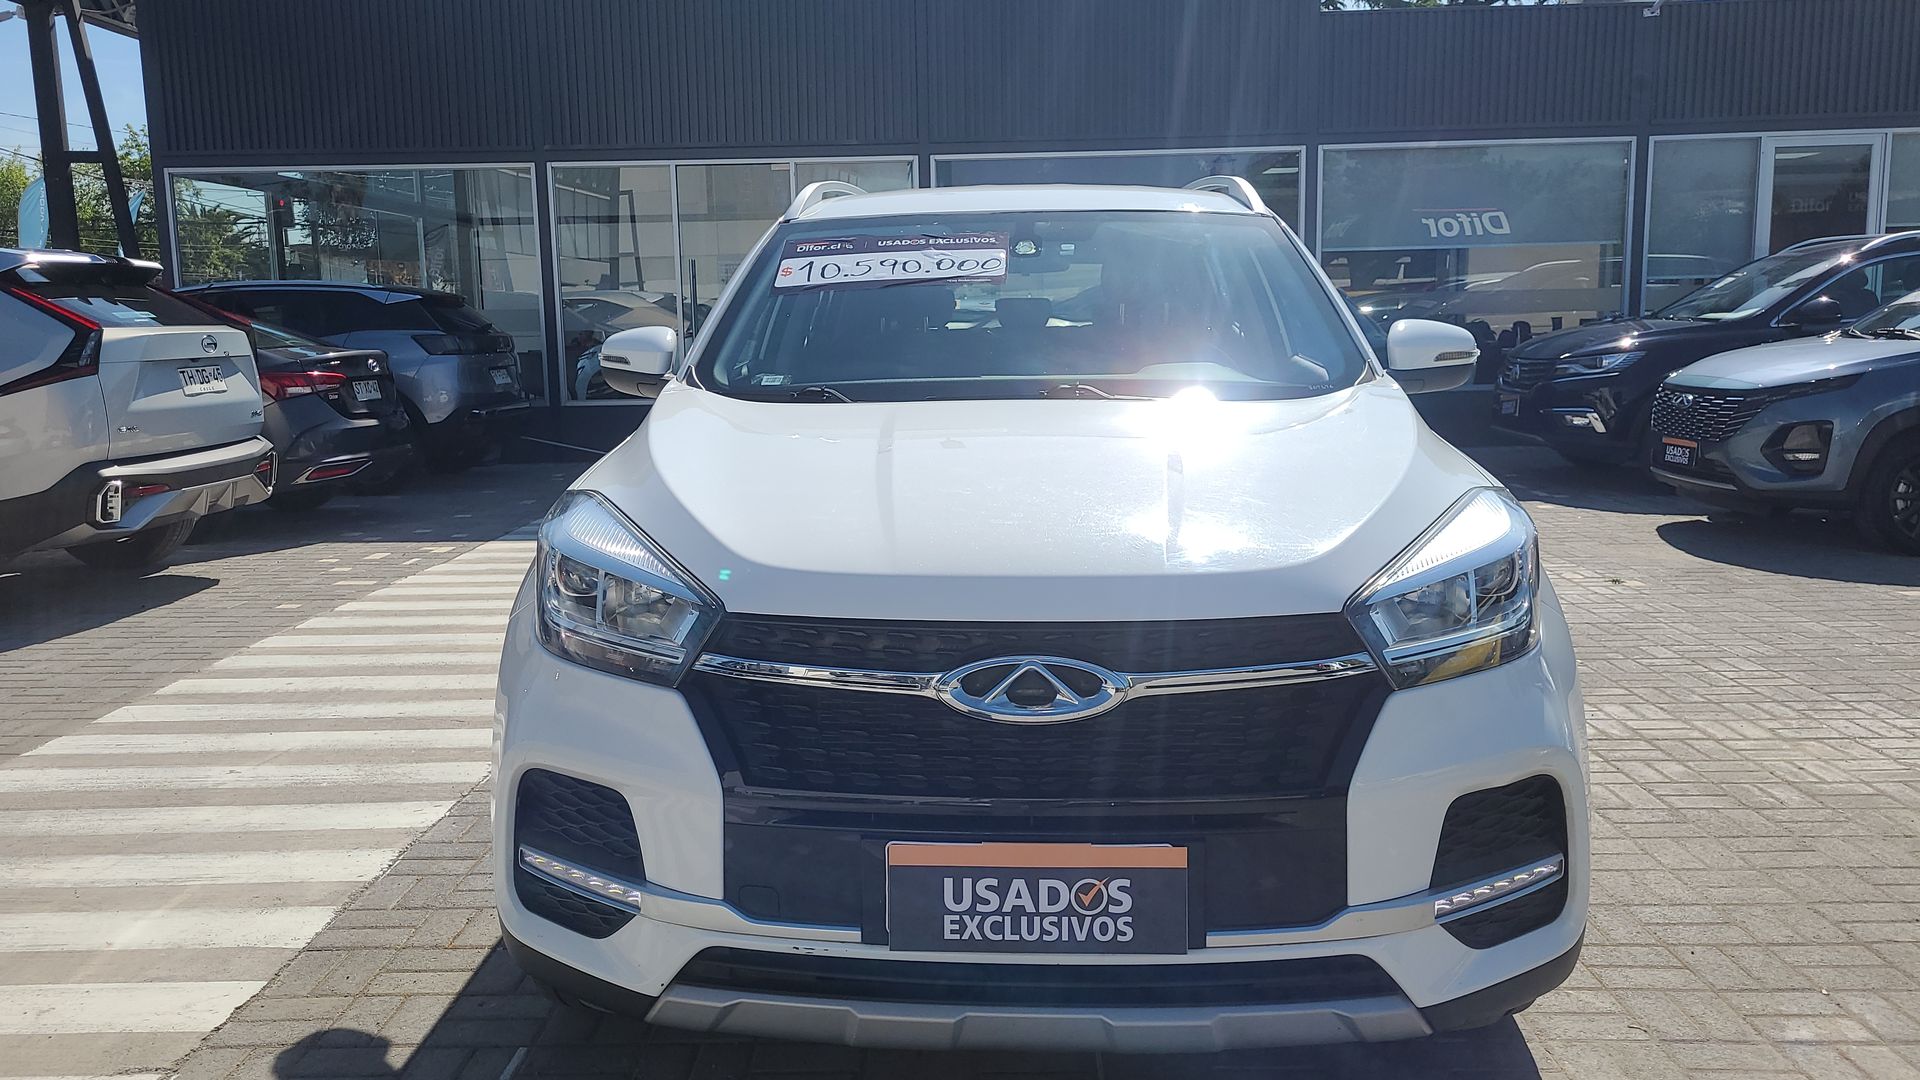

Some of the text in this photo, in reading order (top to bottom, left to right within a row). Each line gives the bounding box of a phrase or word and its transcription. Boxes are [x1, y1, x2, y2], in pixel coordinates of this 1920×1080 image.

[878, 236, 996, 247] USADOS EXCLUSIVOS
[780, 257, 1002, 283] $ 10.590.000
[1665, 454, 1688, 464] EXCLUSIVOS
[1666, 445, 1690, 457] USADOS
[943, 876, 1133, 915] USADOS
[943, 915, 1134, 942] EXCLUSIVOS
